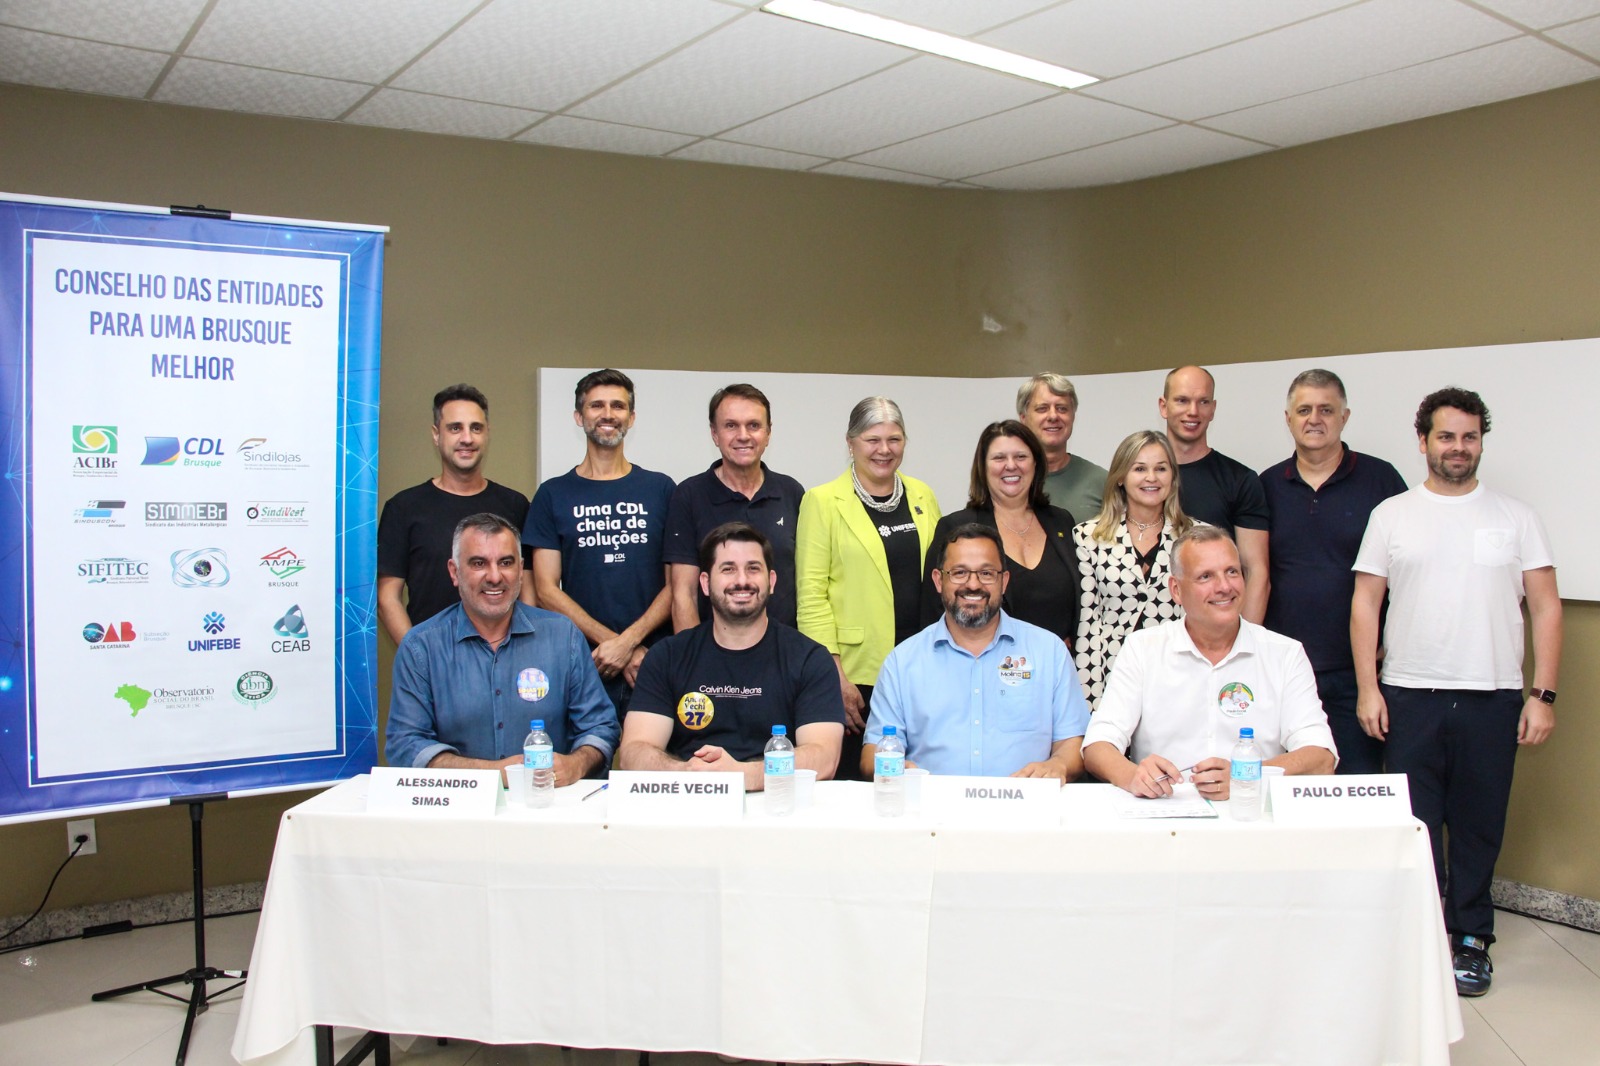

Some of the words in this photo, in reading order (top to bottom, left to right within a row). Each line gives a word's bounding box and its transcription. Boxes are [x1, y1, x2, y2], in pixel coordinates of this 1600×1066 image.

[55, 268, 166, 298] CONSELHO
[174, 276, 212, 302] DAS
[217, 280, 324, 308] ENTIDADES
[90, 311, 144, 338] PARA
[151, 314, 196, 340] UMA
[202, 317, 292, 345] BRUSQUE
[151, 354, 235, 381] MELHOR
[184, 437, 224, 456] CDL
[74, 456, 118, 468] ACIBr
[184, 458, 222, 468] Brusque
[244, 452, 302, 464] Sindilojas
[146, 504, 226, 519] SIMMEBr
[573, 504, 612, 518] Uma
[616, 502, 648, 515] CDL
[576, 516, 620, 532] cheia
[626, 516, 647, 528] de
[578, 530, 648, 550] soluções
[78, 562, 148, 576] SIFITEC
[259, 559, 306, 567] AMPE
[82, 622, 136, 643] OAB
[188, 638, 240, 651] UNIFEBE
[272, 640, 310, 653] CEAB
[154, 685, 214, 698] Observatório
[699, 685, 724, 693] Calvin
[724, 686, 740, 694] Klein
[740, 686, 762, 694] Jeans
[684, 712, 706, 726] 27
[396, 778, 478, 790] ALESSANDRO
[630, 780, 680, 794] ANDRÉ
[684, 783, 729, 794] VECHI
[965, 788, 1024, 800] MOLINA
[1292, 786, 1342, 798] PAULO
[1347, 785, 1396, 798] ECCEL
[412, 796, 450, 806] SIMAS
